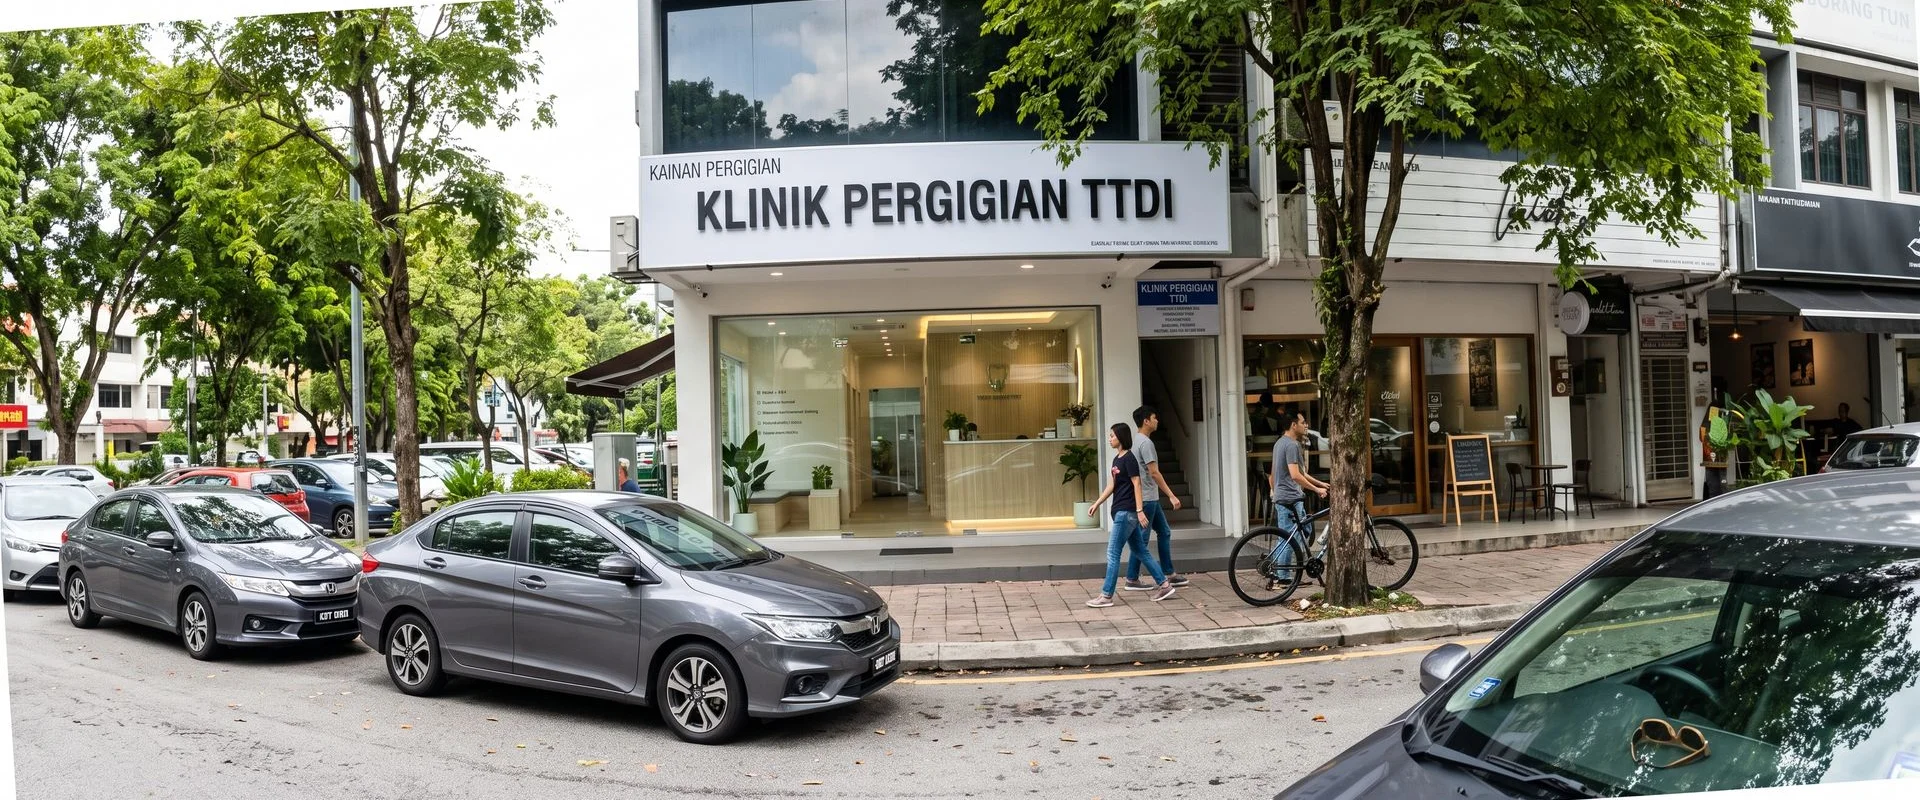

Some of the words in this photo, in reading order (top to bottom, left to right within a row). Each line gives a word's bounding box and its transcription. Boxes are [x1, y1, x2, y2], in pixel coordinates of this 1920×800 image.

[649, 162, 701, 181] KAINAN
[706, 157, 781, 177] PERGIGIAN
[697, 185, 830, 231] KLINIK
[843, 178, 1068, 225] PERGIGIAN
[1081, 178, 1174, 219] TTDI
[1141, 284, 1168, 293] KLINIK
[1169, 283, 1214, 293] PERGIGIAN
[1169, 294, 1188, 303] TTDI
